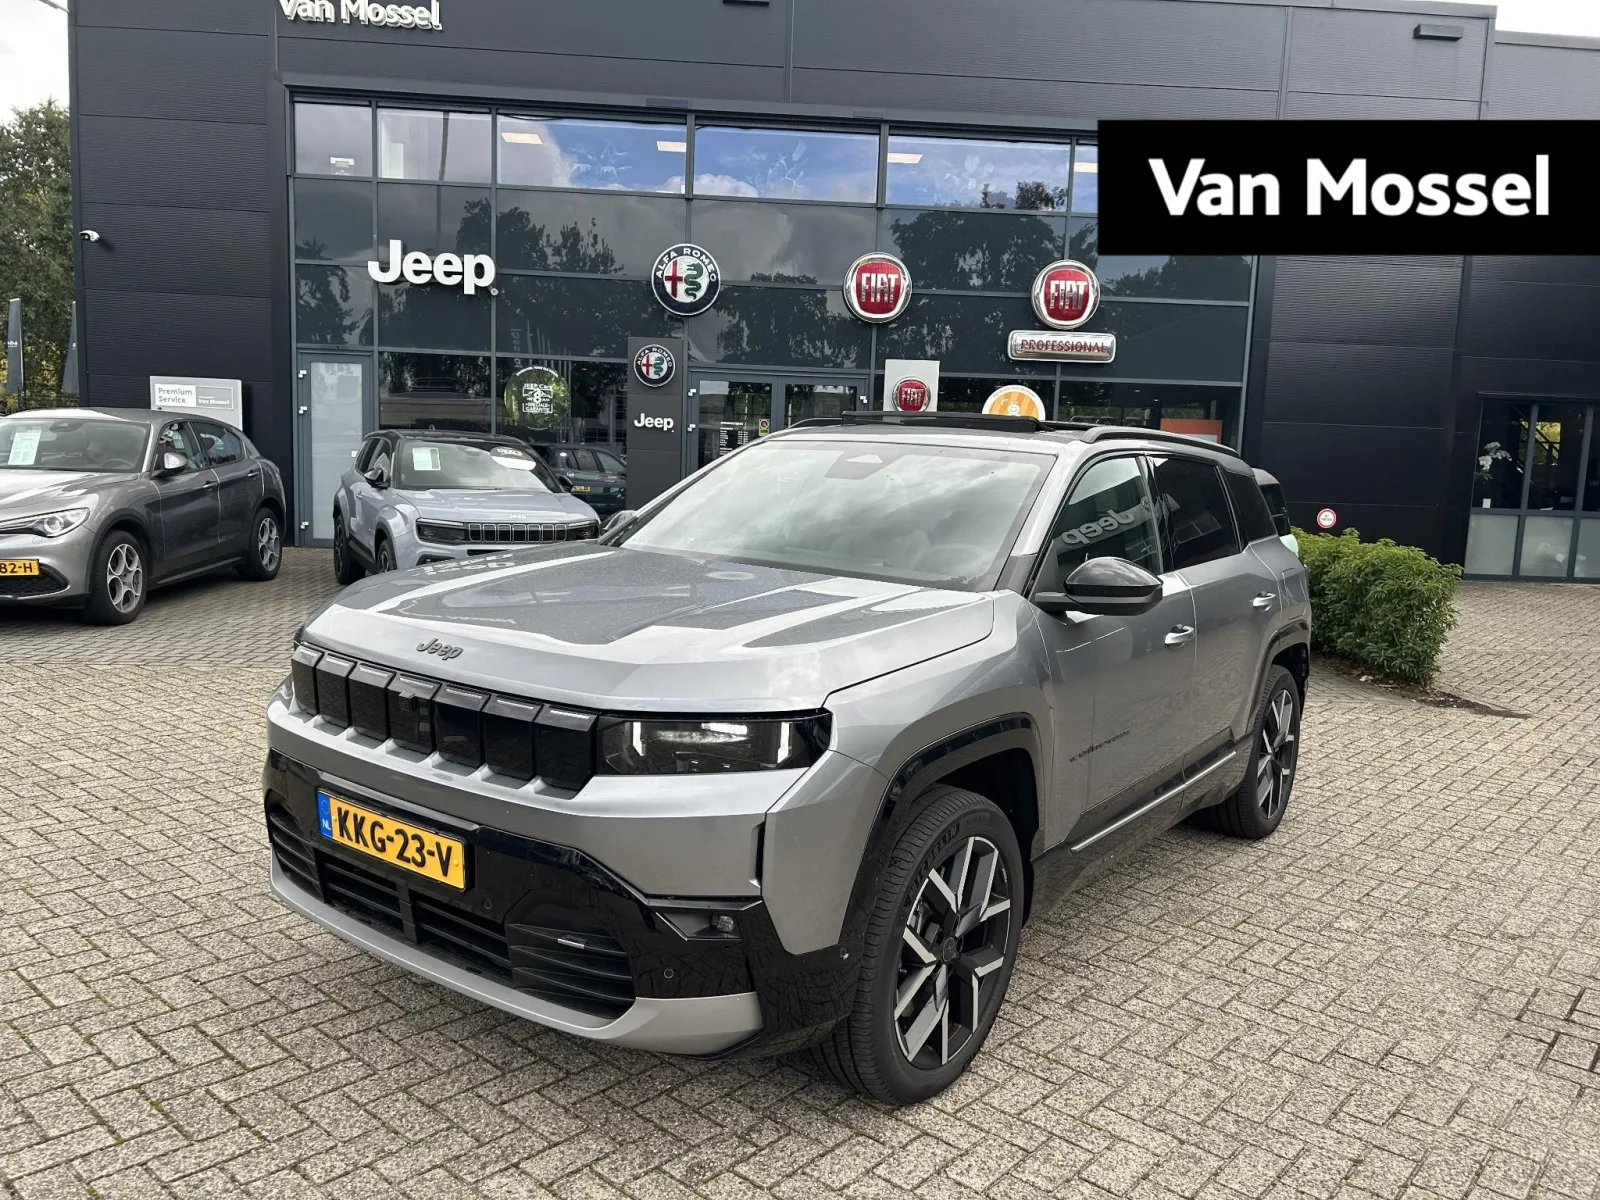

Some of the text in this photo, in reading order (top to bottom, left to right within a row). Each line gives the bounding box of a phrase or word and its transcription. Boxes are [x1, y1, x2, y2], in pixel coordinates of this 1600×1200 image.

[279, 0, 442, 30] Van Mossel
[367, 239, 496, 295] Jeep
[655, 247, 717, 282] ALFA ROMEO
[861, 272, 899, 303] FIAT
[1049, 280, 1088, 310] FIAT
[1020, 339, 1106, 354] PROFESSIONAL
[636, 347, 673, 368] ALFA ROMEO
[158, 387, 193, 396] Premium
[158, 395, 187, 404] Service
[902, 387, 924, 406] FIAT
[633, 412, 674, 431] Jeep
[0, 562, 33, 574] 82-H
[416, 637, 464, 661] Jeep
[322, 819, 332, 831] NL
[336, 806, 453, 878] KKG-23-V
